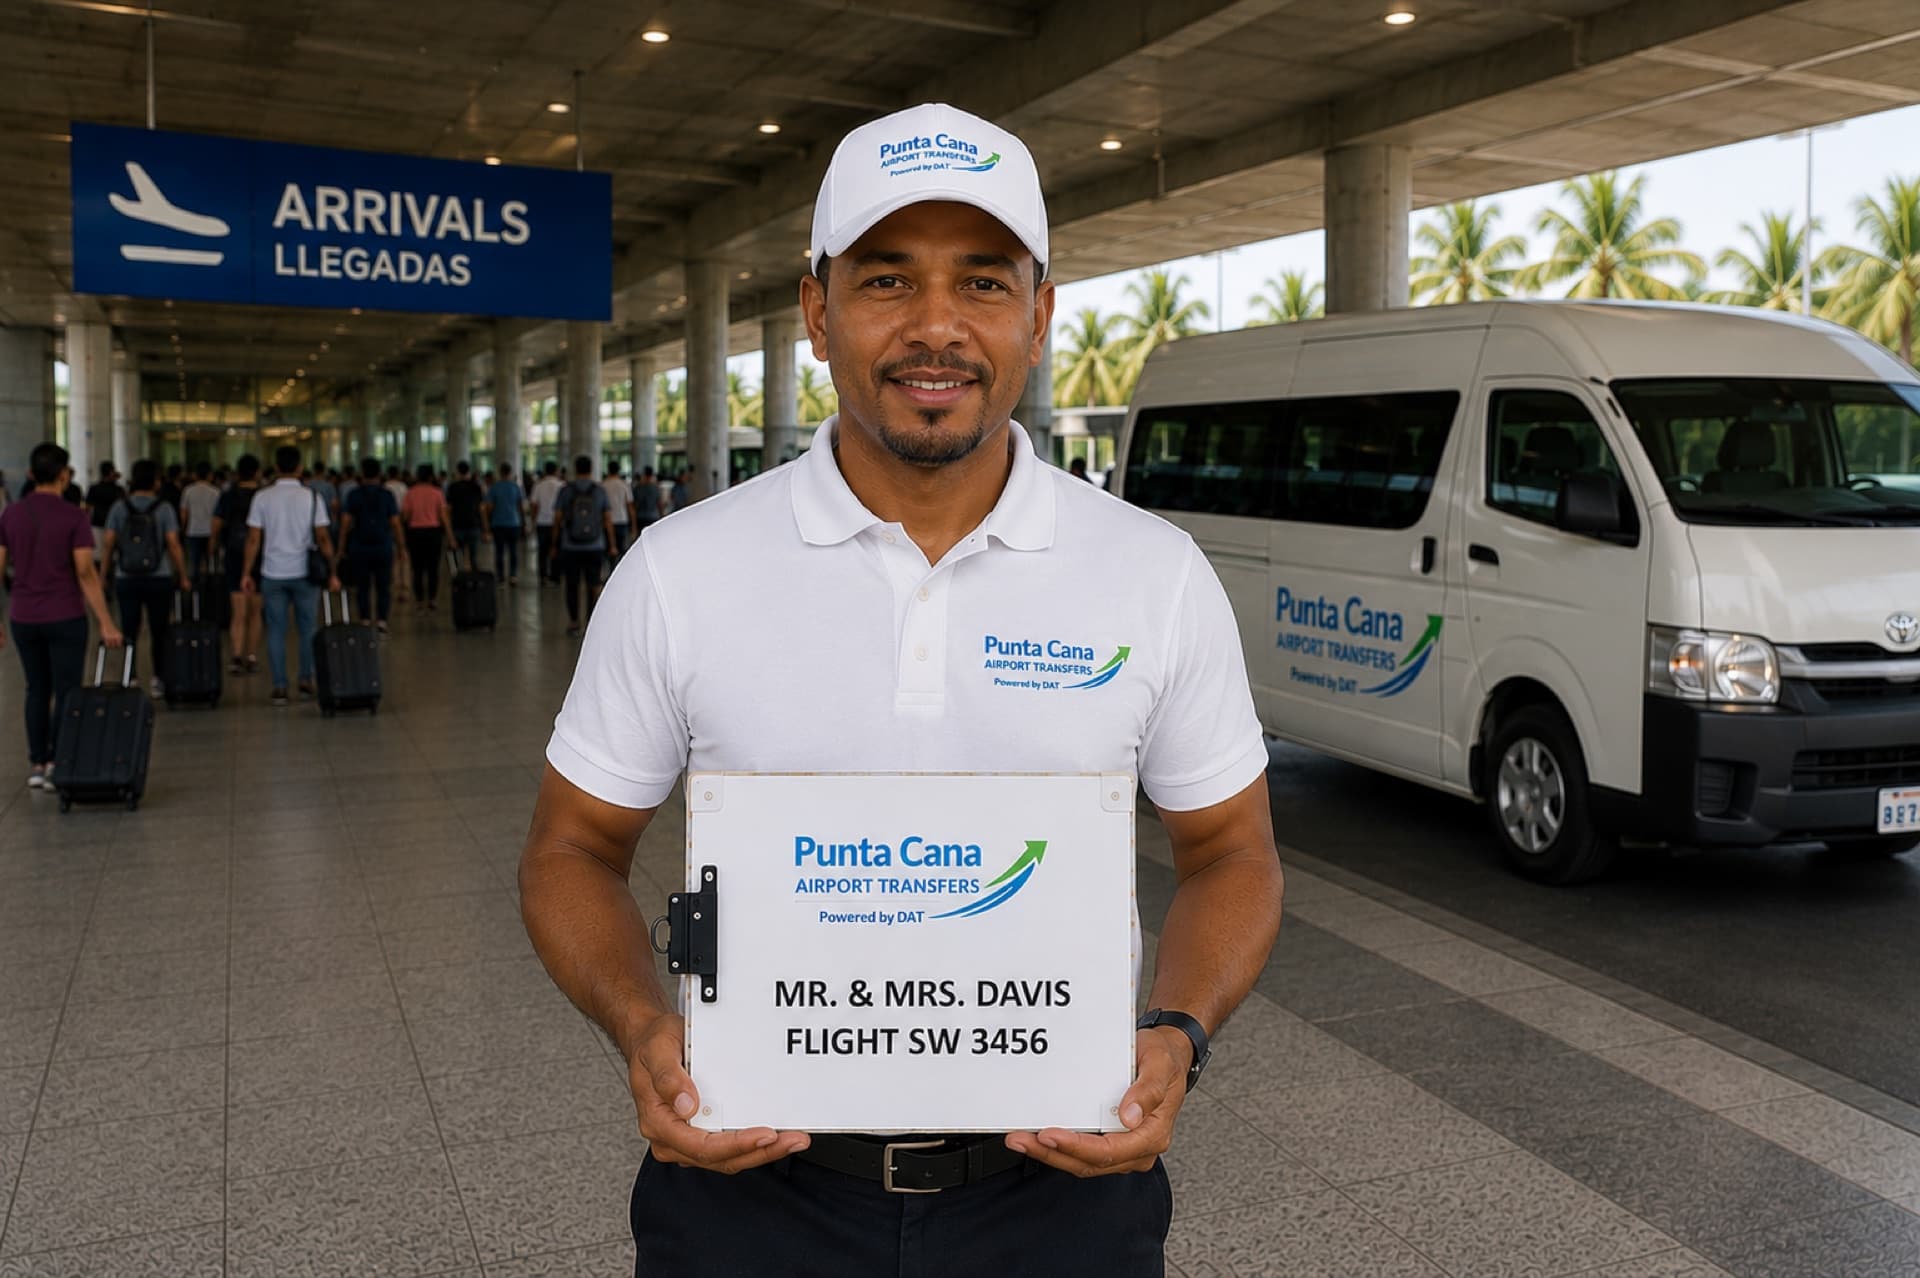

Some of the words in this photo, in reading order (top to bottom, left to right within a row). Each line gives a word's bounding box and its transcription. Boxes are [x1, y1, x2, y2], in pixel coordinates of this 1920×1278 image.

[880, 136, 931, 158] Punta
[935, 134, 978, 155] Cana
[881, 152, 920, 168] AIRPORT
[890, 164, 921, 176] Powered
[272, 183, 531, 245] ARRIVALS
[274, 243, 472, 286] LLEGADAS
[1276, 586, 1338, 630] Punta
[1344, 597, 1403, 641] Cana
[984, 635, 1042, 657] Punta
[1047, 640, 1094, 660] Cana
[1276, 632, 1324, 657] AIRPORT
[1327, 641, 1395, 672] TRANSFERS
[984, 659, 1031, 671] AIRPORT
[1033, 662, 1092, 675] TRANSFERS
[1290, 666, 1325, 688] Powered
[1327, 677, 1337, 693] by
[1338, 677, 1357, 693] DAT
[994, 677, 1030, 688] Powered
[1031, 681, 1041, 690] by
[1042, 681, 1059, 690] DAT
[795, 836, 891, 867] Punta
[900, 836, 982, 867] Cana
[795, 879, 873, 894] AIRPORT
[877, 879, 980, 894] TRANSFERS
[819, 911, 876, 924] Powered
[879, 911, 894, 926] by
[897, 911, 925, 924] DAT
[775, 980, 837, 1007] MR.
[849, 980, 873, 1008] &
[885, 980, 965, 1008] MRS.
[977, 980, 1071, 1008] DAVIS
[786, 1028, 899, 1055] FLIGHT
[908, 1028, 961, 1055] SW
[971, 1028, 1048, 1055] 3456
